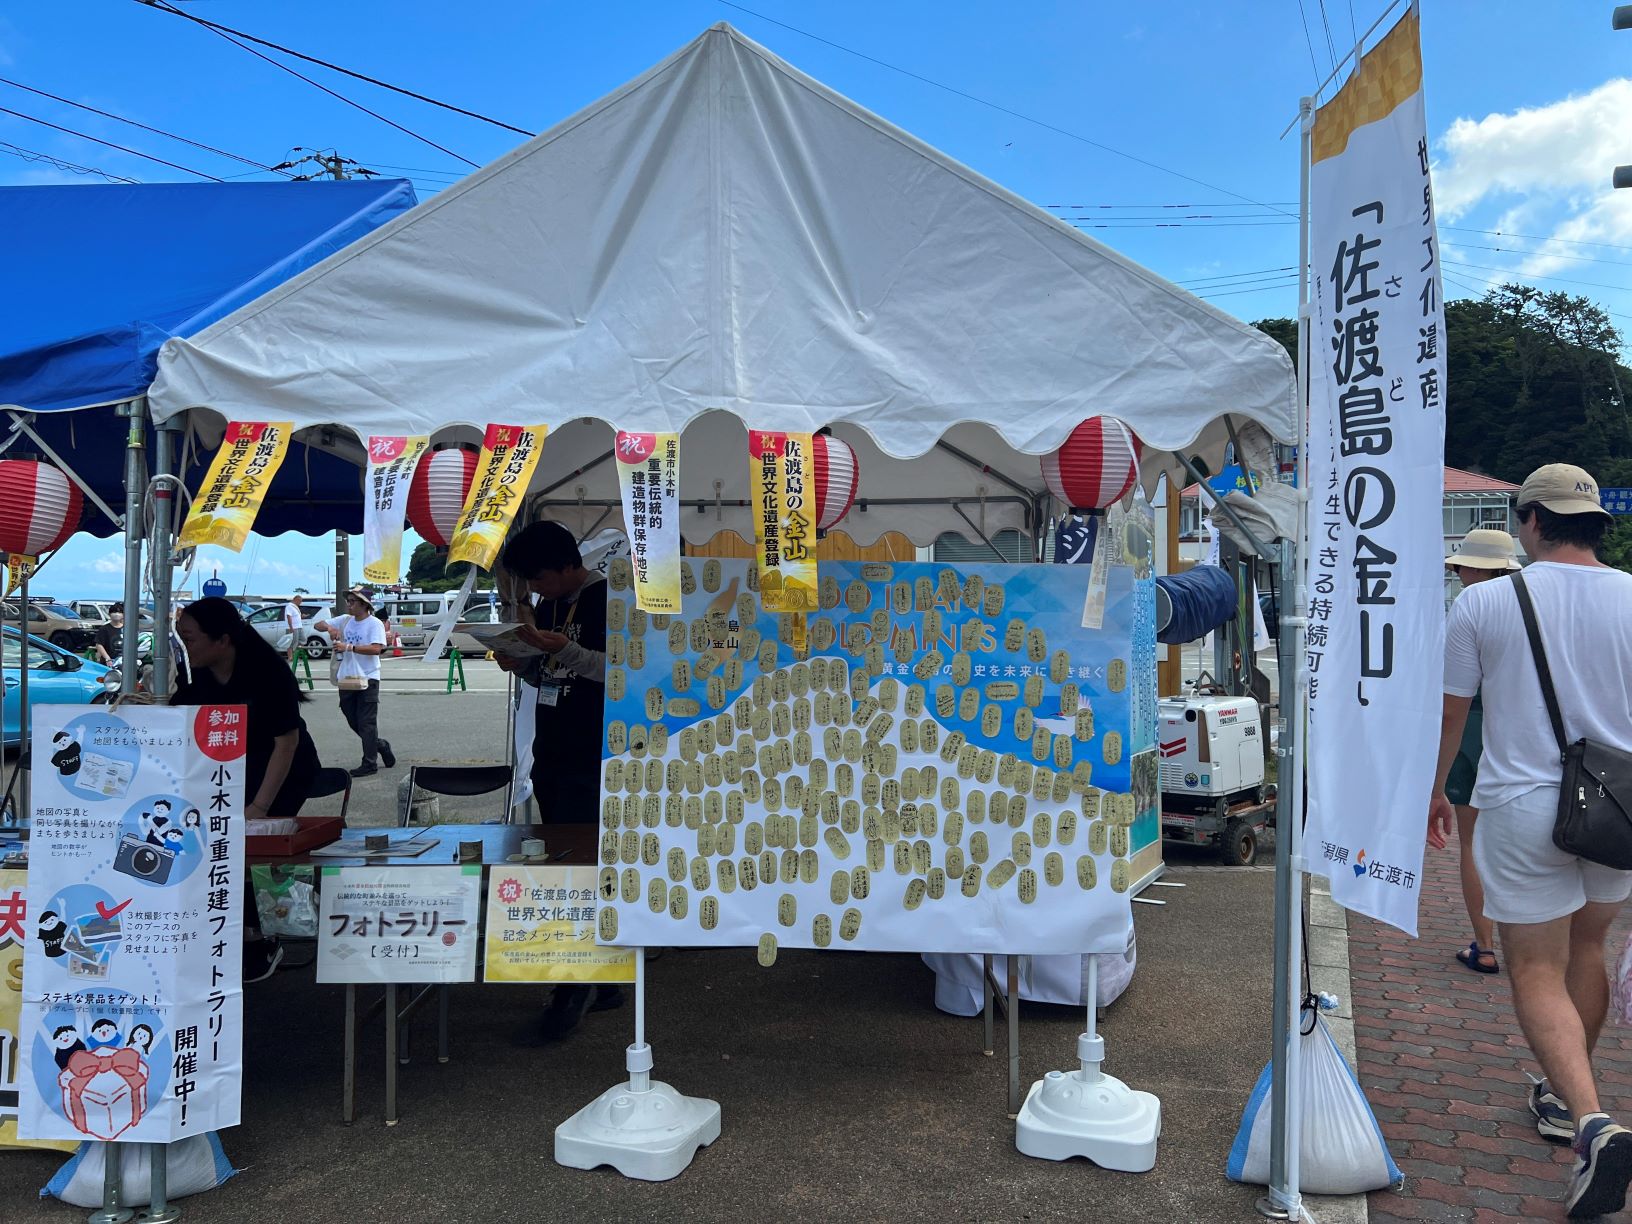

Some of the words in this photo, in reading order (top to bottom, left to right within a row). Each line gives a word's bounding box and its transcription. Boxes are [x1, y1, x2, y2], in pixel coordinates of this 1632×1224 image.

[238, 423, 253, 437] 祝
[495, 428, 511, 442] 祝
[371, 440, 395, 457] 祝
[619, 434, 646, 455] 祝
[760, 435, 776, 449] 祝
[479, 431, 534, 522] 佐渡島の金山
[665, 439, 676, 498] 佐渡市小木町
[647, 458, 663, 529] 重要伝統的
[782, 440, 811, 563] 佐渡島の金山
[761, 452, 780, 567] 世界文化遺産登録
[207, 709, 240, 725] 参加
[95, 726, 148, 735] スタッフから
[207, 730, 239, 747] 無料
[36, 808, 89, 817] 地図の写真と
[36, 818, 124, 829] 同じ写真を撮りながら
[1368, 859, 1416, 889] 佐渡市
[502, 883, 518, 899] 祝
[206, 764, 232, 1062] 小木町重伝建フォトラリー
[507, 906, 596, 921] 世界文化遺産
[126, 922, 181, 931] このブースの
[329, 910, 467, 937] フォトラリー
[125, 932, 198, 943] スタッフに写真を
[371, 944, 420, 958] 【受付】
